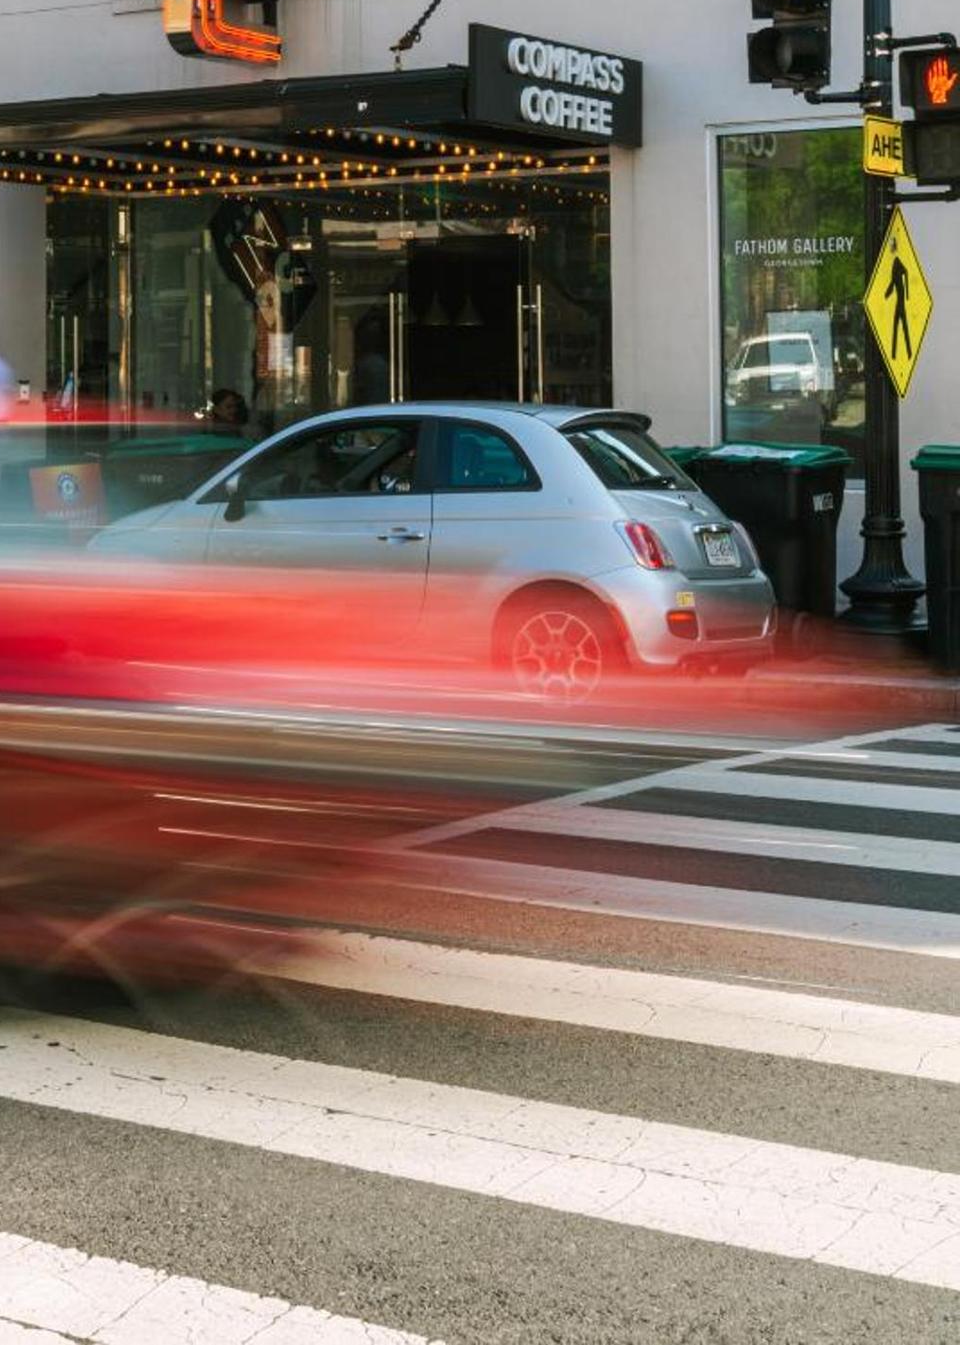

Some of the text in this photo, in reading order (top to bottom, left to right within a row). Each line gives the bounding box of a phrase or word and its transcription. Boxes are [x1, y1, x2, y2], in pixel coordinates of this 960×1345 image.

[507, 37, 624, 94] COMPASS
[520, 86, 613, 136] COFFEE
[871, 133, 901, 160] AHE
[735, 236, 854, 255] FATHOM GALLERY
